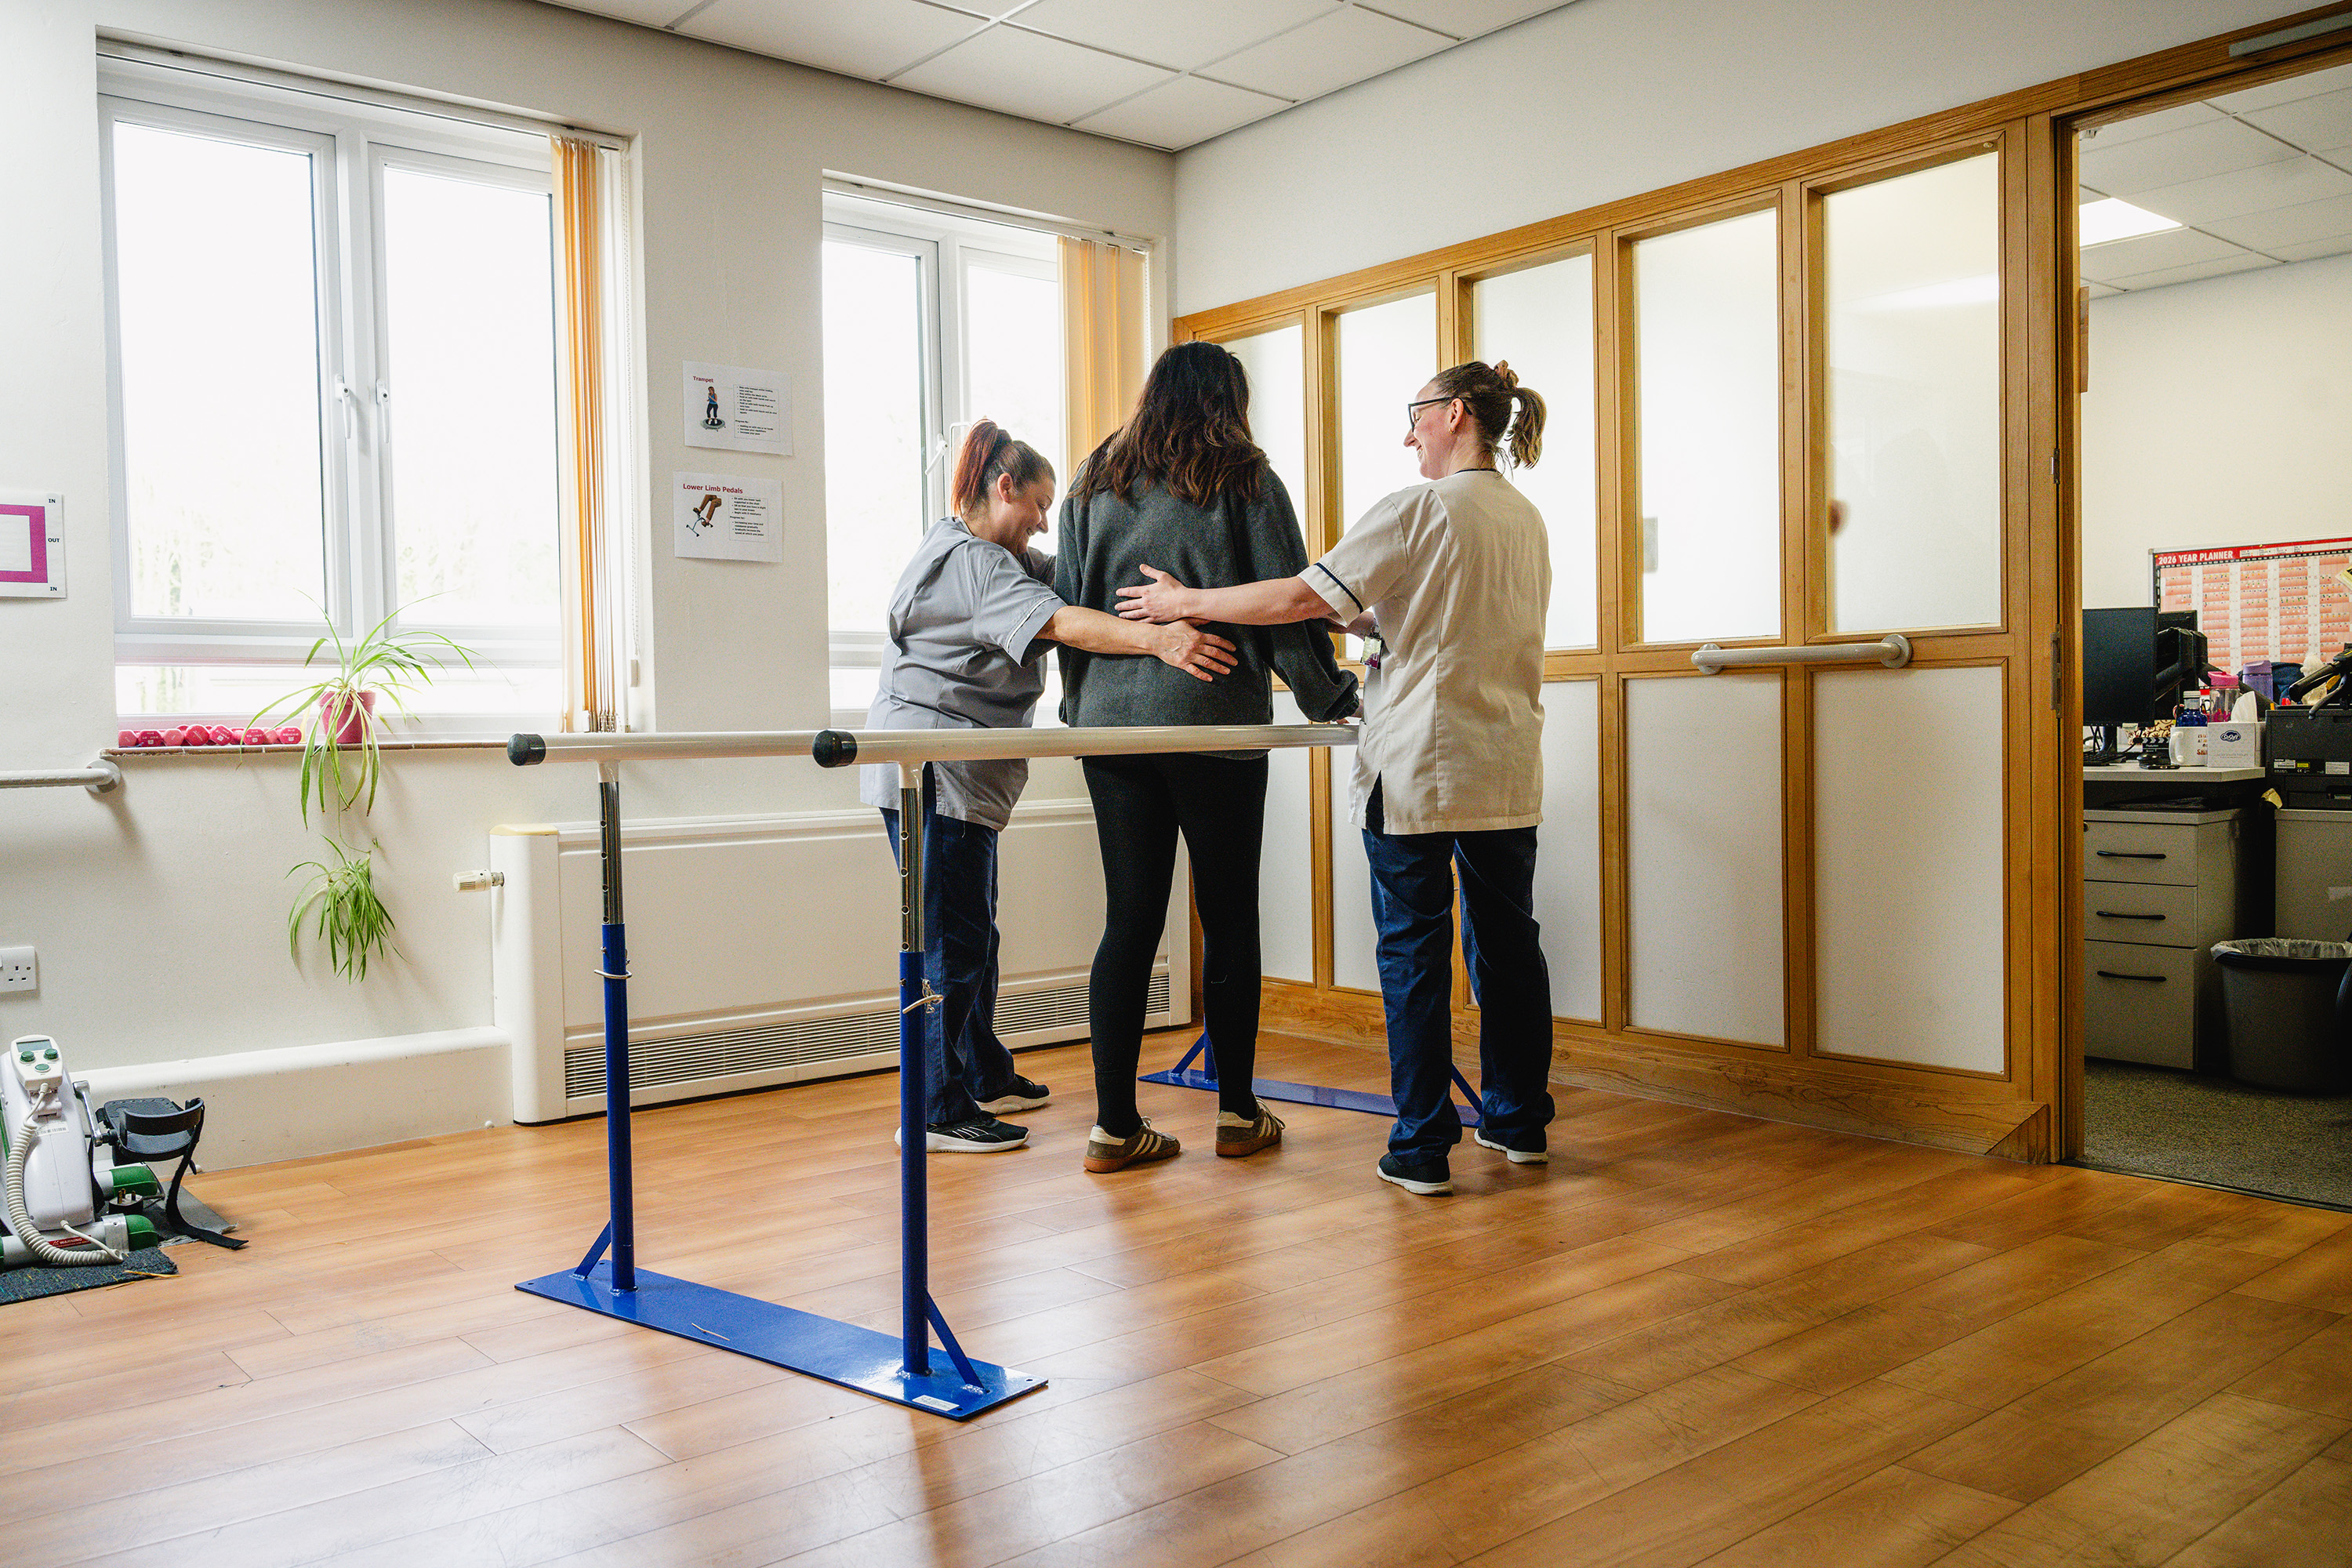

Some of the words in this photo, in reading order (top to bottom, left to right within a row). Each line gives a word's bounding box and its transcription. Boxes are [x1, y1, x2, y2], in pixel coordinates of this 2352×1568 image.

[2158, 555, 2177, 564] 2026
[2179, 553, 2198, 563] YEAR
[2199, 550, 2234, 561] PLANNER
